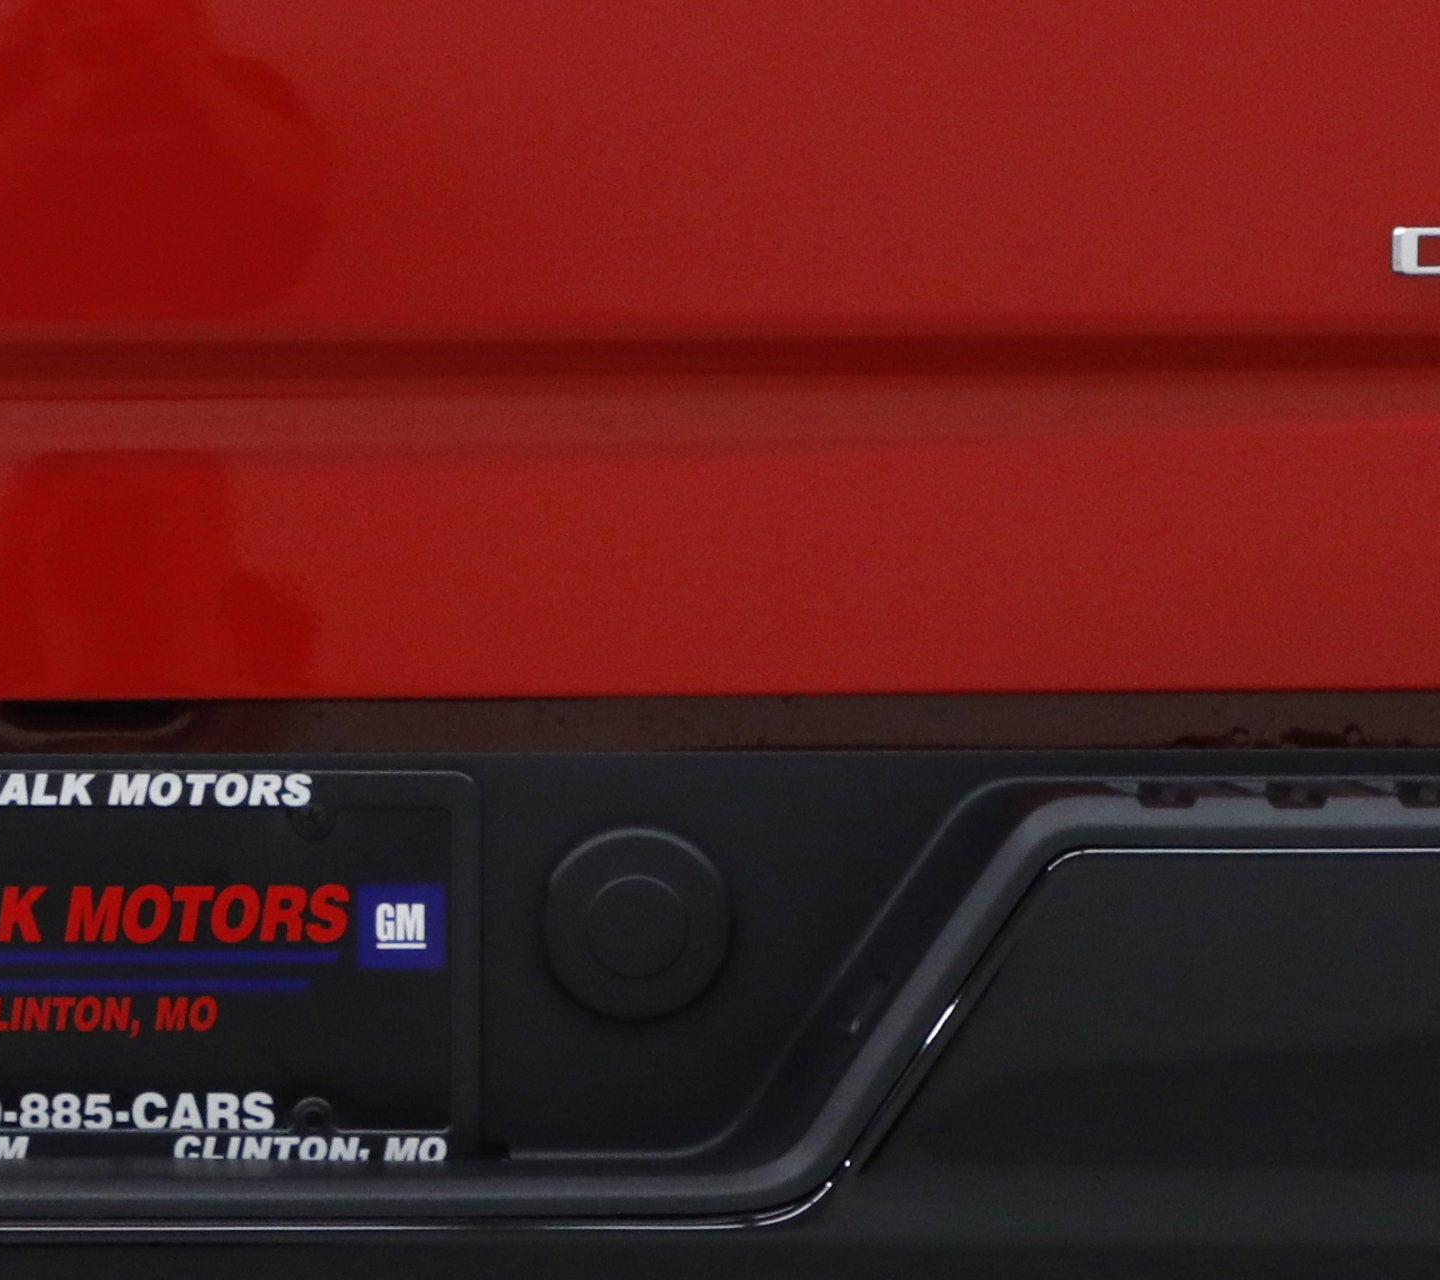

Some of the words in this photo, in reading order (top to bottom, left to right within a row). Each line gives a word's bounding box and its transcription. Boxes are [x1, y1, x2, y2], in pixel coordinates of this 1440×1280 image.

[107, 772, 314, 809] MOTORS
[62, 883, 352, 945] MOTORS
[374, 902, 427, 943] GM
[154, 995, 220, 1034] MO
[172, 1134, 372, 1162] CLINTON,
[382, 1136, 449, 1163] MO
